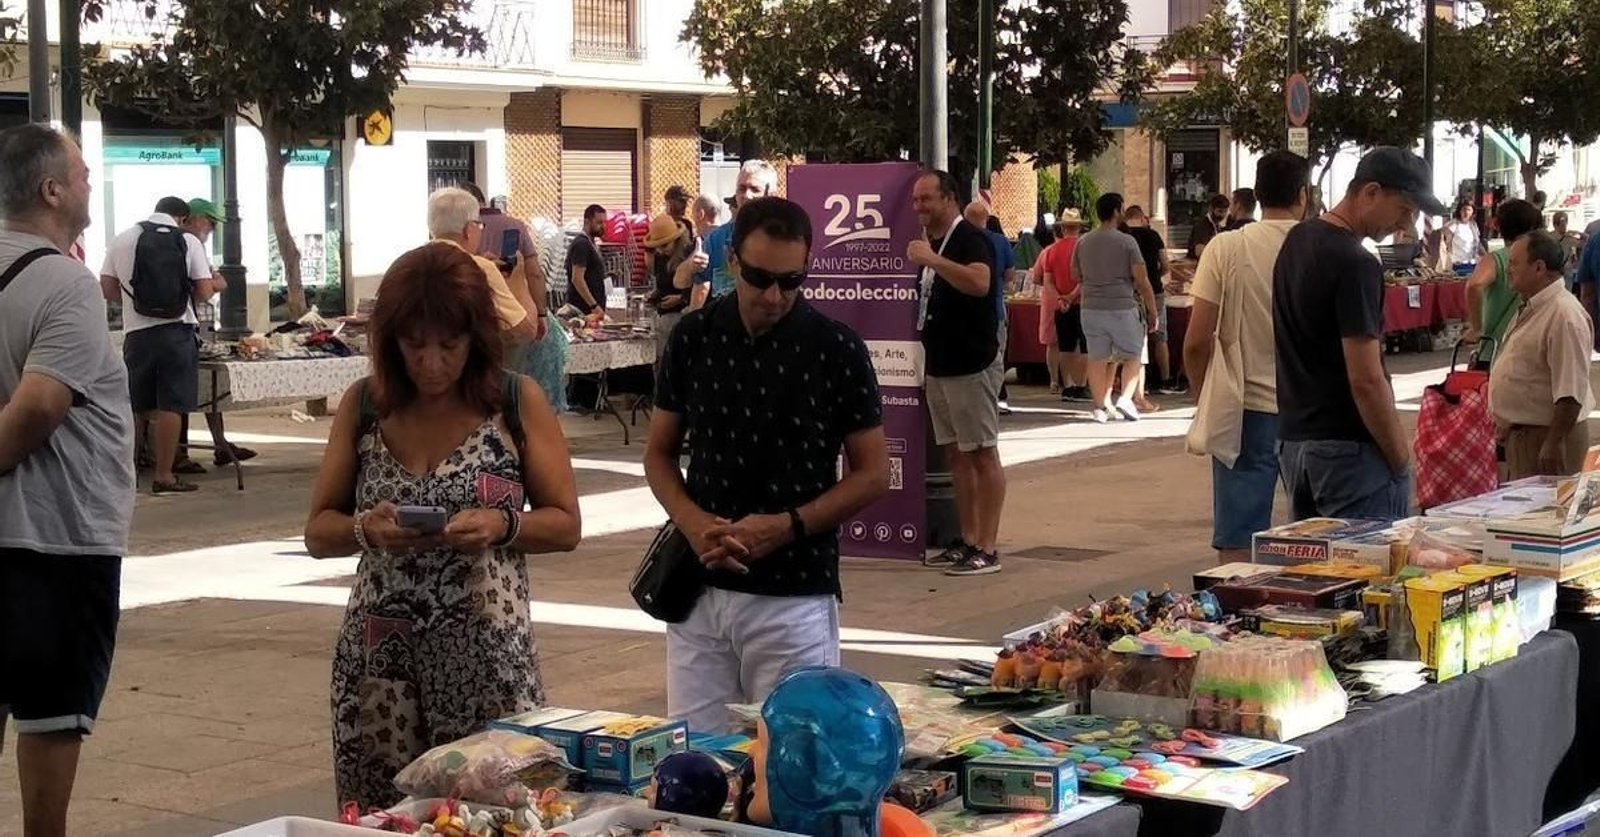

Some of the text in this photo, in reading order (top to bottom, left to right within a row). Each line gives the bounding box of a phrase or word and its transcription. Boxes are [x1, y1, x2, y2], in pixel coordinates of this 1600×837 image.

[139, 151, 183, 162] AgroBank
[824, 194, 883, 236] 25
[845, 243, 890, 252] 1997-2022
[812, 257, 904, 270] ANIVERSARIO
[885, 349, 907, 361] Arte,
[881, 395, 919, 406] Subasta
[1287, 545, 1325, 559] FERIA
